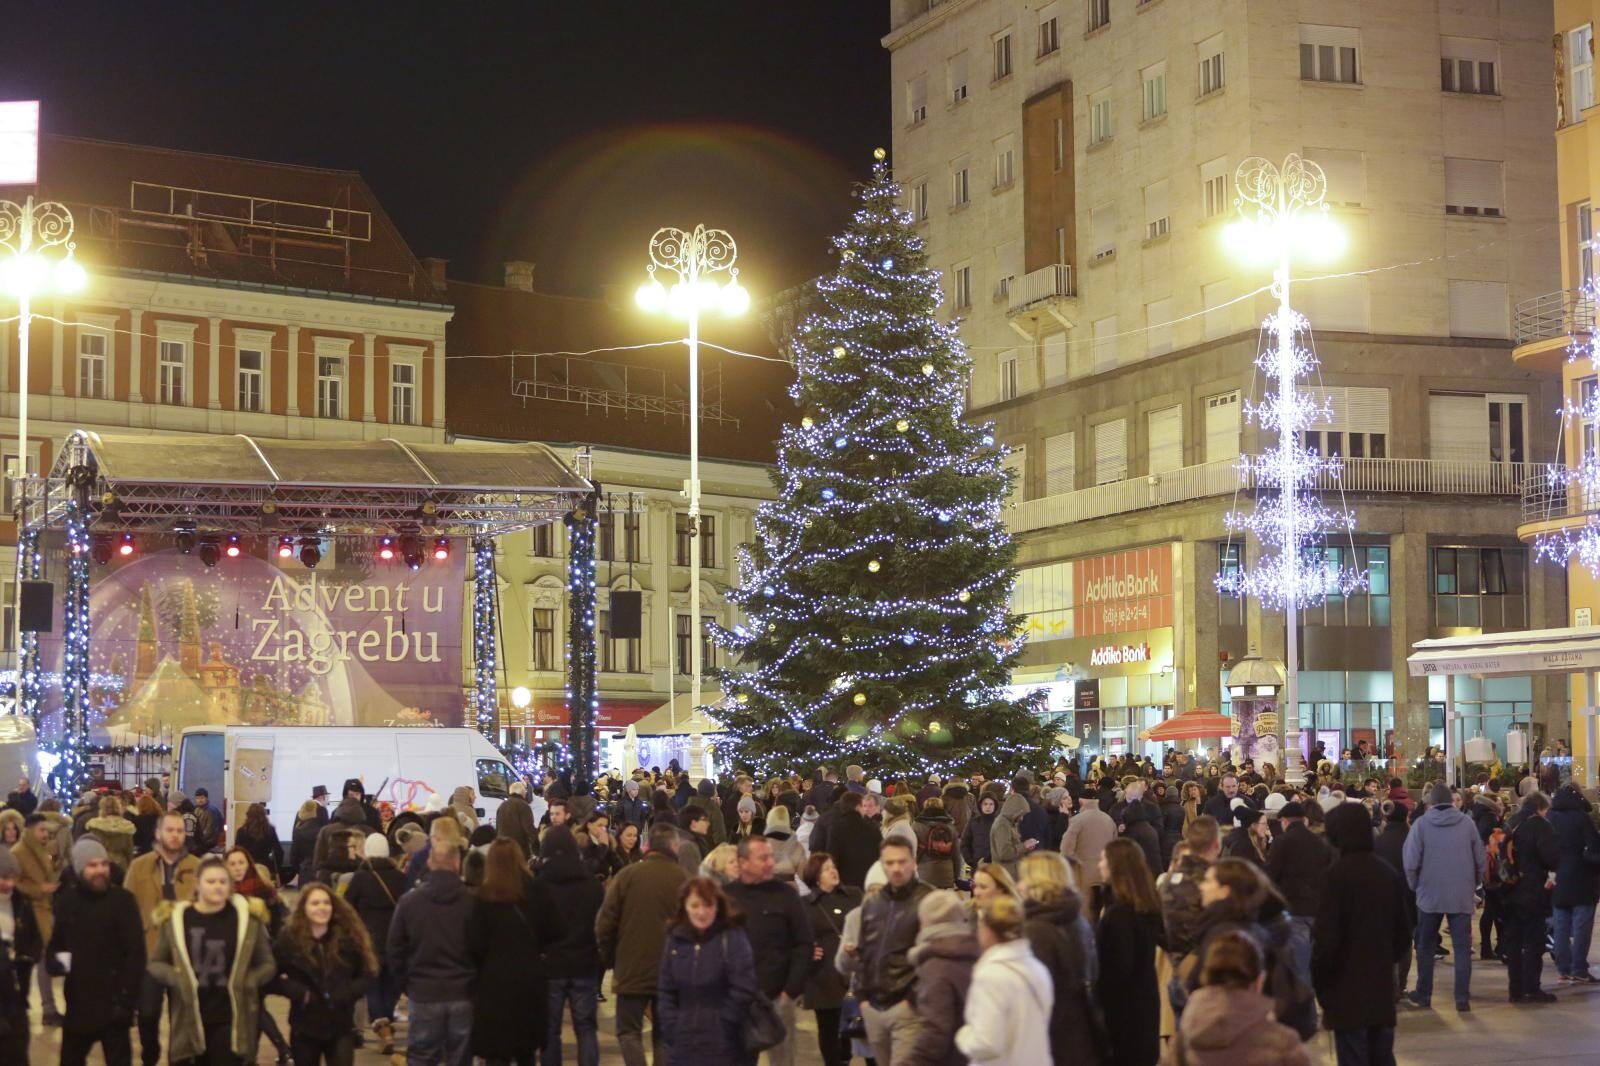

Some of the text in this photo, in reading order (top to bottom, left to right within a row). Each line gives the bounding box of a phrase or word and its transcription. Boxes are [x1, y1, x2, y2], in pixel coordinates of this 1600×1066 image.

[261, 572, 443, 612] Advent u
[1085, 568, 1159, 602] Addiko Bank
[251, 615, 443, 675] Zagrebu
[1090, 642, 1147, 666] Addiko Bank
[190, 927, 227, 987] LA
